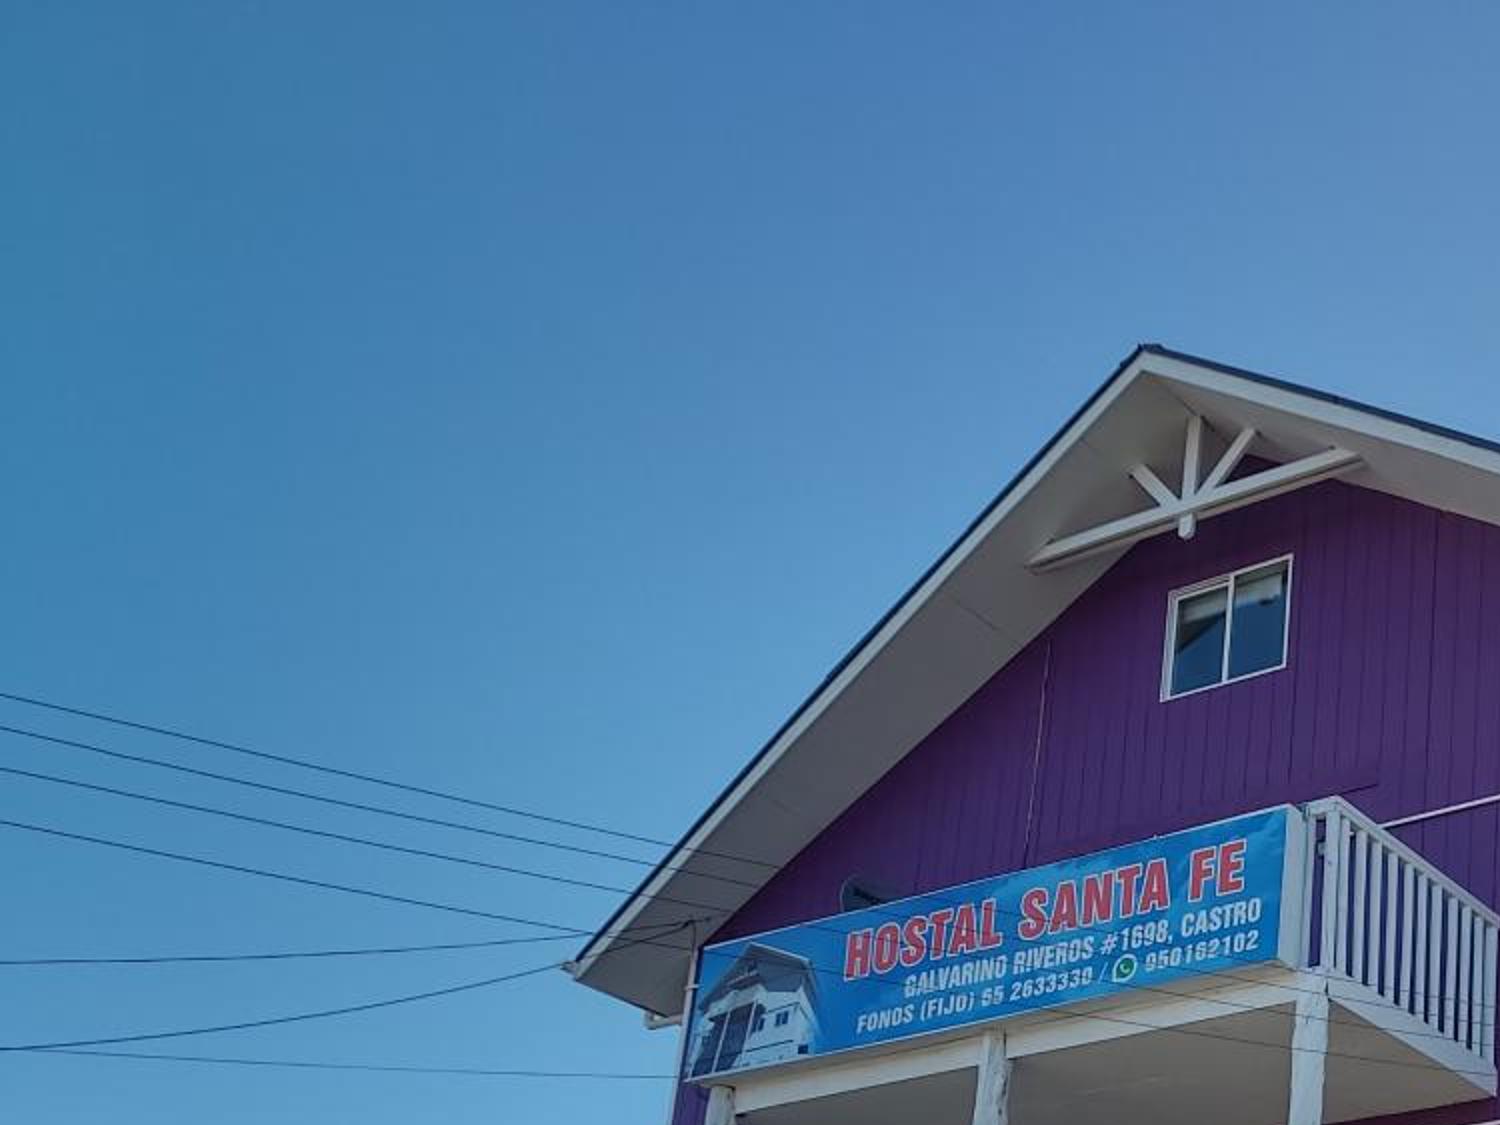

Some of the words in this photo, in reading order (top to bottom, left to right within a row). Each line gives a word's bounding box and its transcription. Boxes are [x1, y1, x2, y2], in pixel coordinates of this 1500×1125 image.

[843, 897, 1003, 982] HOSTAL
[1018, 857, 1171, 940] SANTA
[1187, 838, 1248, 903] FE
[904, 954, 1008, 998] GALVARINO
[1013, 935, 1095, 975] RIVEROS
[1101, 919, 1173, 955] #1698,
[1181, 897, 1262, 938] CASTRO
[856, 1003, 915, 1034] FONOS
[920, 991, 976, 1022] (FIJO)
[1010, 966, 1093, 1001] 2633330
